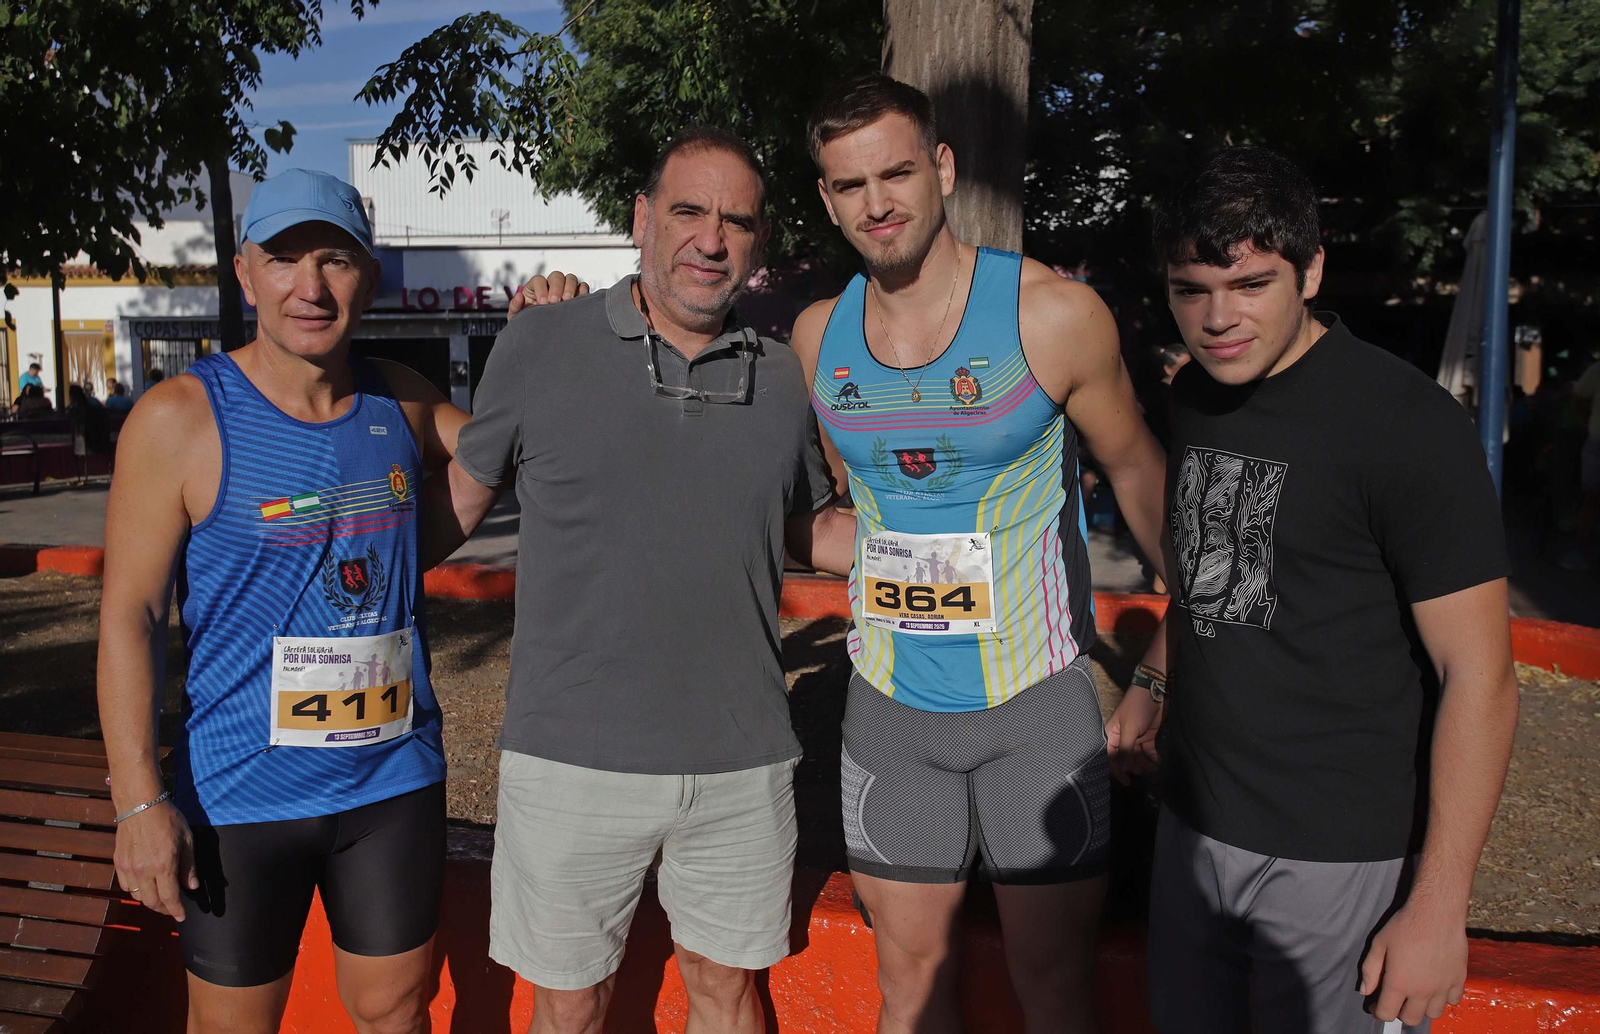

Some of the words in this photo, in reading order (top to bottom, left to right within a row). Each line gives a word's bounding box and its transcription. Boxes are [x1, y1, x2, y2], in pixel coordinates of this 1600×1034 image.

[401, 287, 439, 311] LO
[453, 286, 492, 311] DE
[135, 321, 179, 337] COPAS
[866, 543, 877, 553] POR
[877, 545, 888, 555] UNA
[889, 546, 913, 558] SONRISA
[875, 581, 976, 612] 364
[328, 620, 360, 631] VETERANS
[1191, 617, 1216, 638] ILA
[283, 653, 299, 664] POR
[300, 653, 317, 664] UNA
[318, 654, 352, 664] SONRISA
[291, 685, 397, 722] 411
